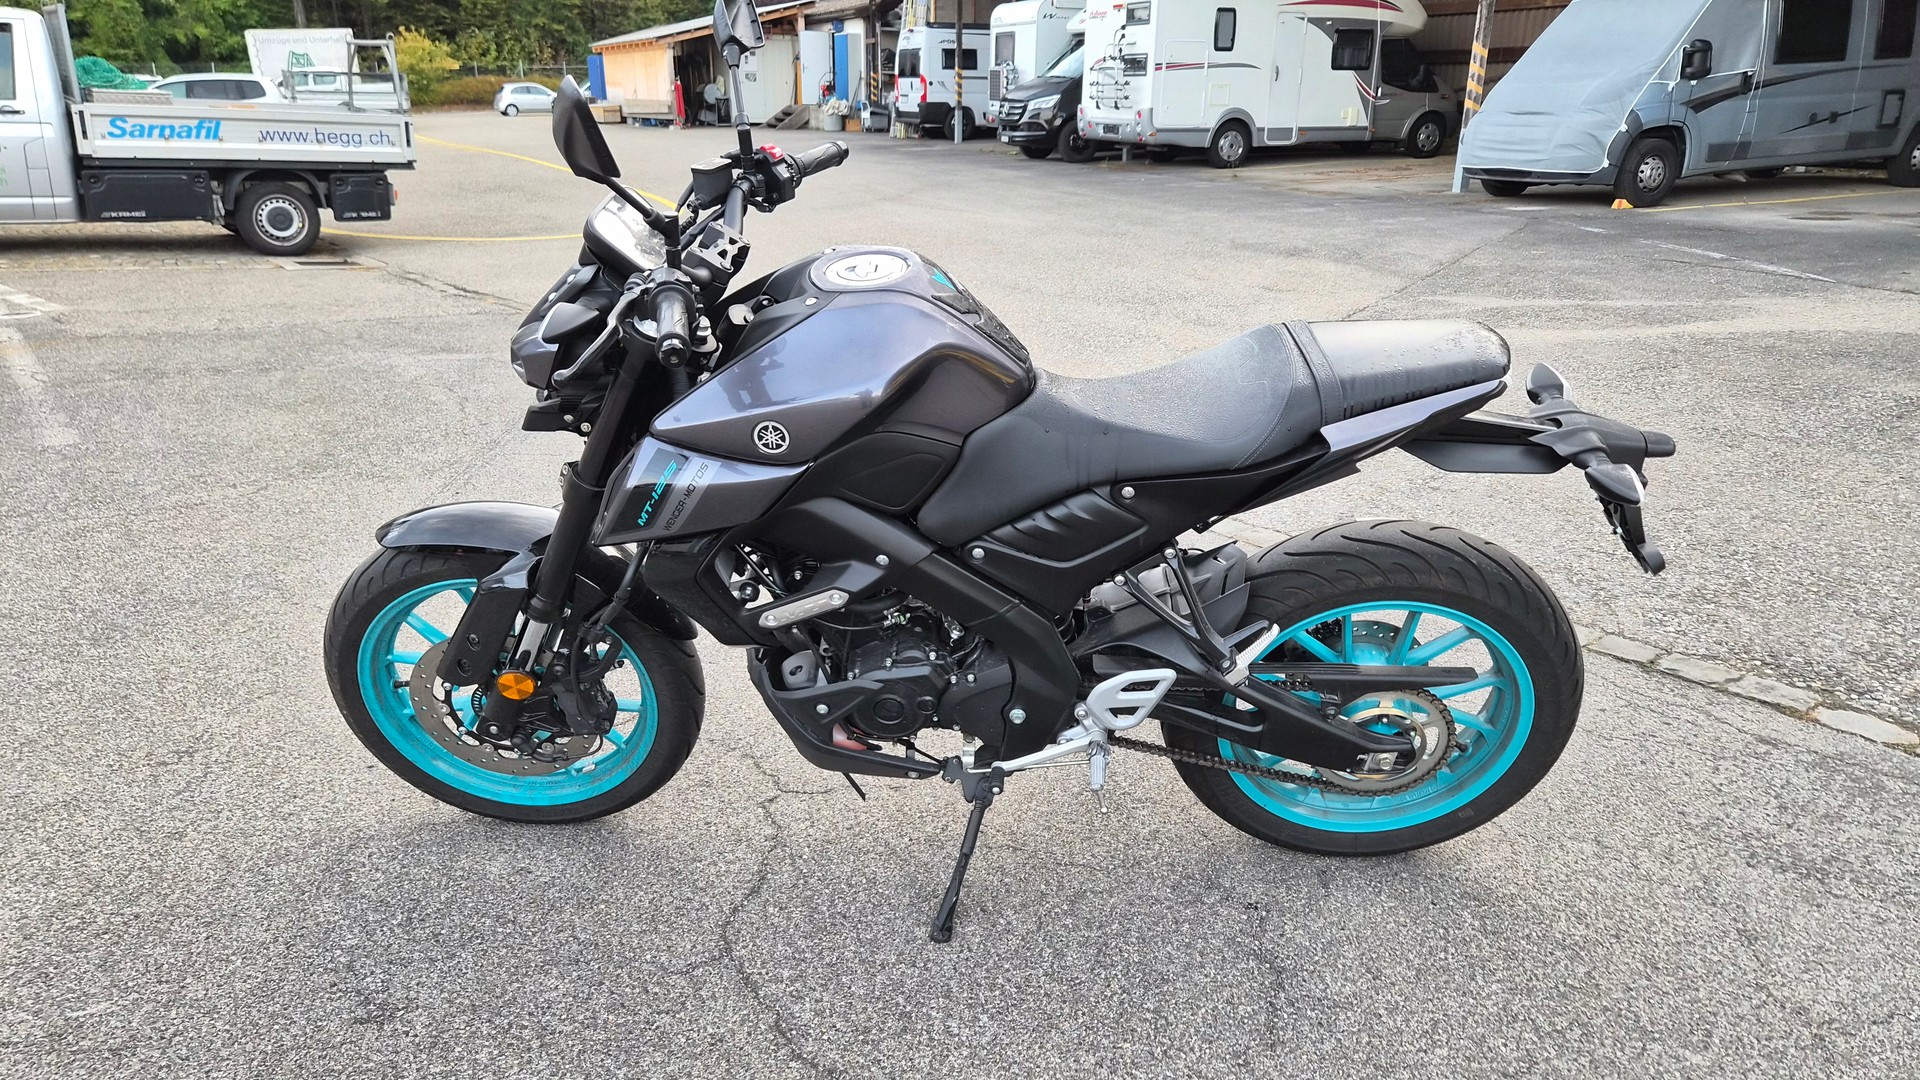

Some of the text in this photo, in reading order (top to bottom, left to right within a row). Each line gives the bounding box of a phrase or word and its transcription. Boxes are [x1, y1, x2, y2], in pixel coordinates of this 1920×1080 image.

[258, 35, 291, 45] Umzüge
[292, 35, 308, 44] und
[107, 116, 222, 140] Sarnafil
[637, 459, 678, 527] MT-125
[663, 462, 709, 532] WENGER-MOTOS
